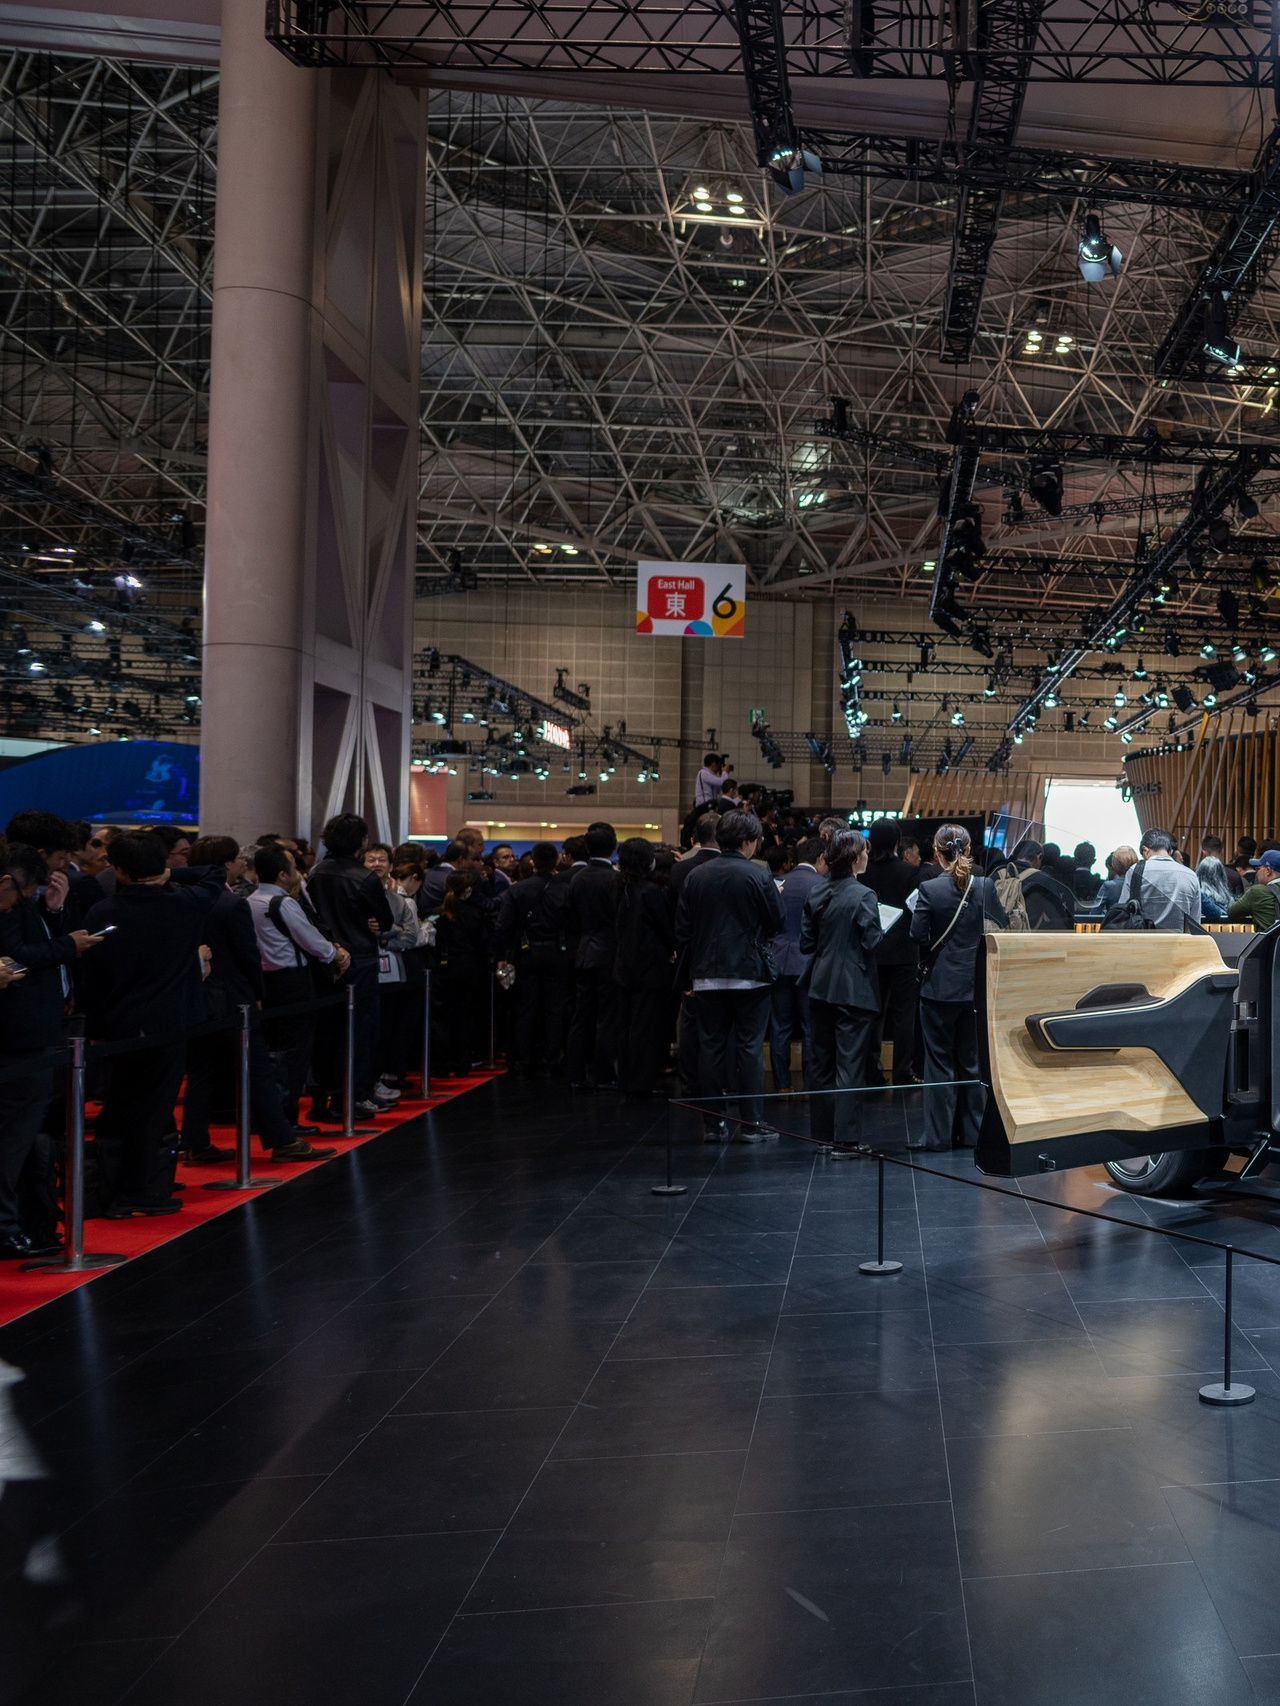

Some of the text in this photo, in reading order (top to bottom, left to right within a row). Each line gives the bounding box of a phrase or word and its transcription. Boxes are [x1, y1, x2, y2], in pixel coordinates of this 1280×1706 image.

[657, 579, 695, 591] East Hall
[665, 592, 687, 617] 東
[712, 583, 737, 619] 6
